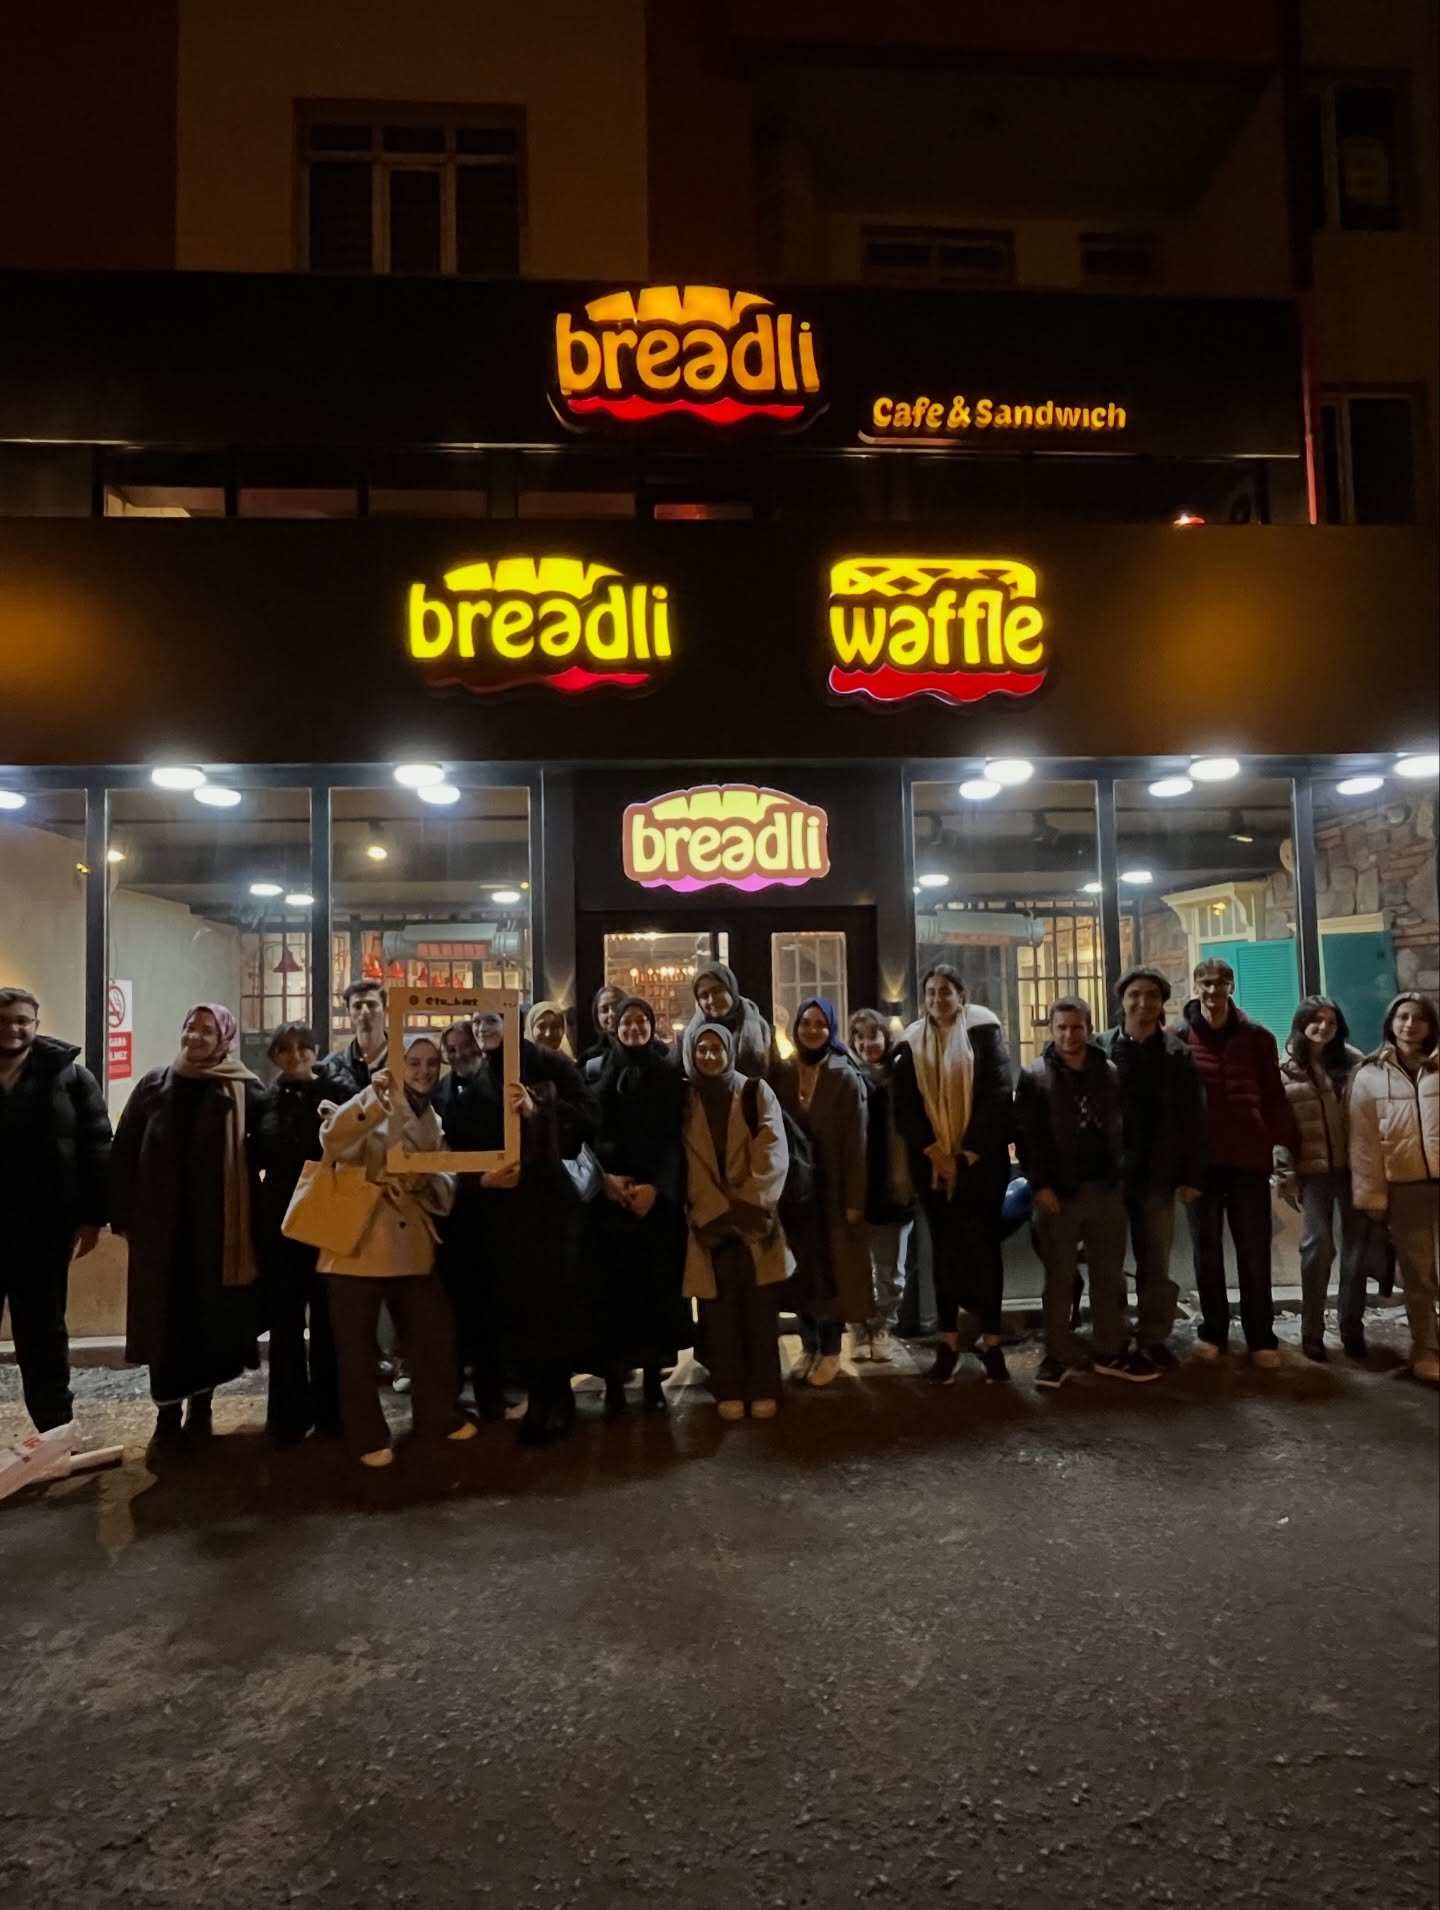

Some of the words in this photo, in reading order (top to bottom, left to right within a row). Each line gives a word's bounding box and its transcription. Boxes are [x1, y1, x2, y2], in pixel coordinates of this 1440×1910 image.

[555, 313, 821, 394] breadli
[409, 583, 672, 661] breadli
[829, 591, 1045, 664] waffle
[632, 811, 821, 873] breadli
